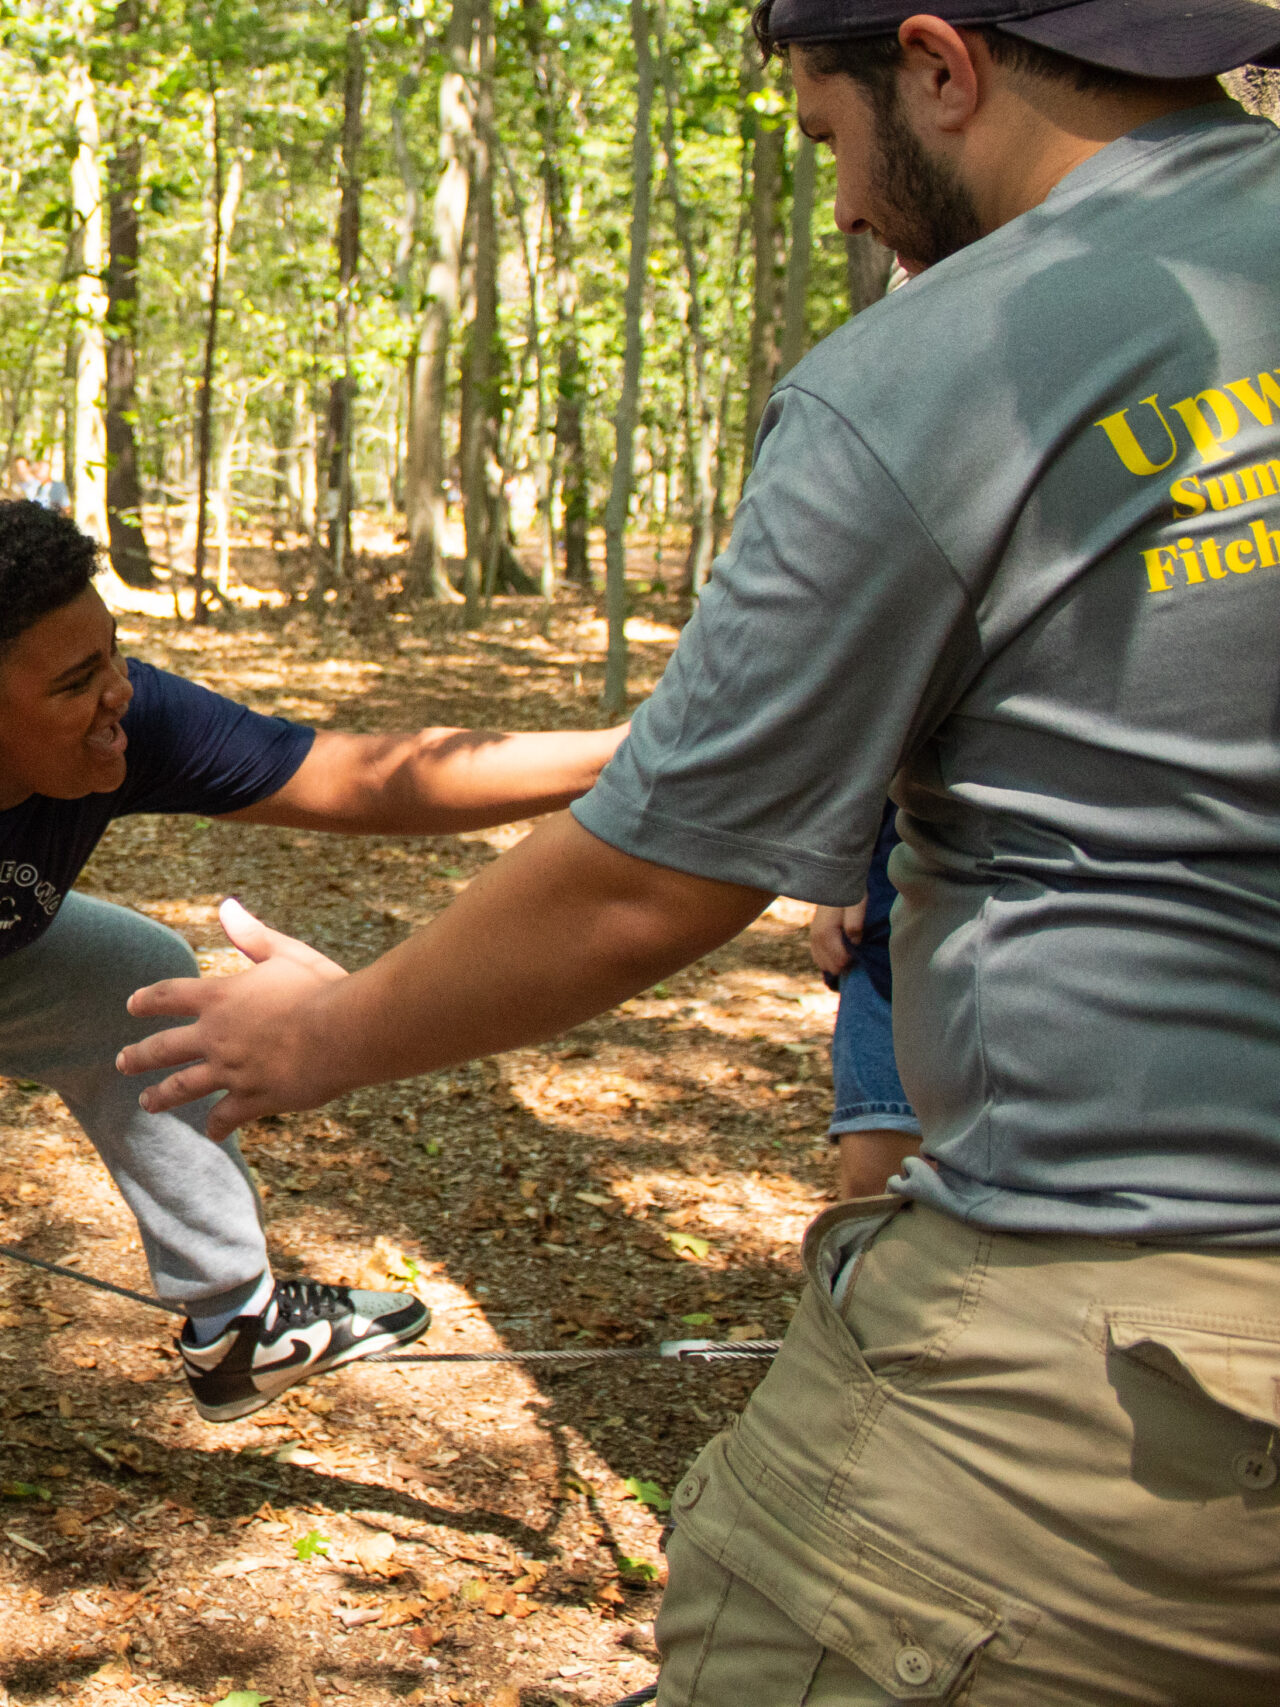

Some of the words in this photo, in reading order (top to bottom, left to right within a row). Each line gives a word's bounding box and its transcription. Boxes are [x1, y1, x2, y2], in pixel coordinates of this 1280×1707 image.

[1094, 368, 1280, 476] Upw
[1170, 459, 1280, 519] Sum
[1140, 519, 1280, 593] Fitch
